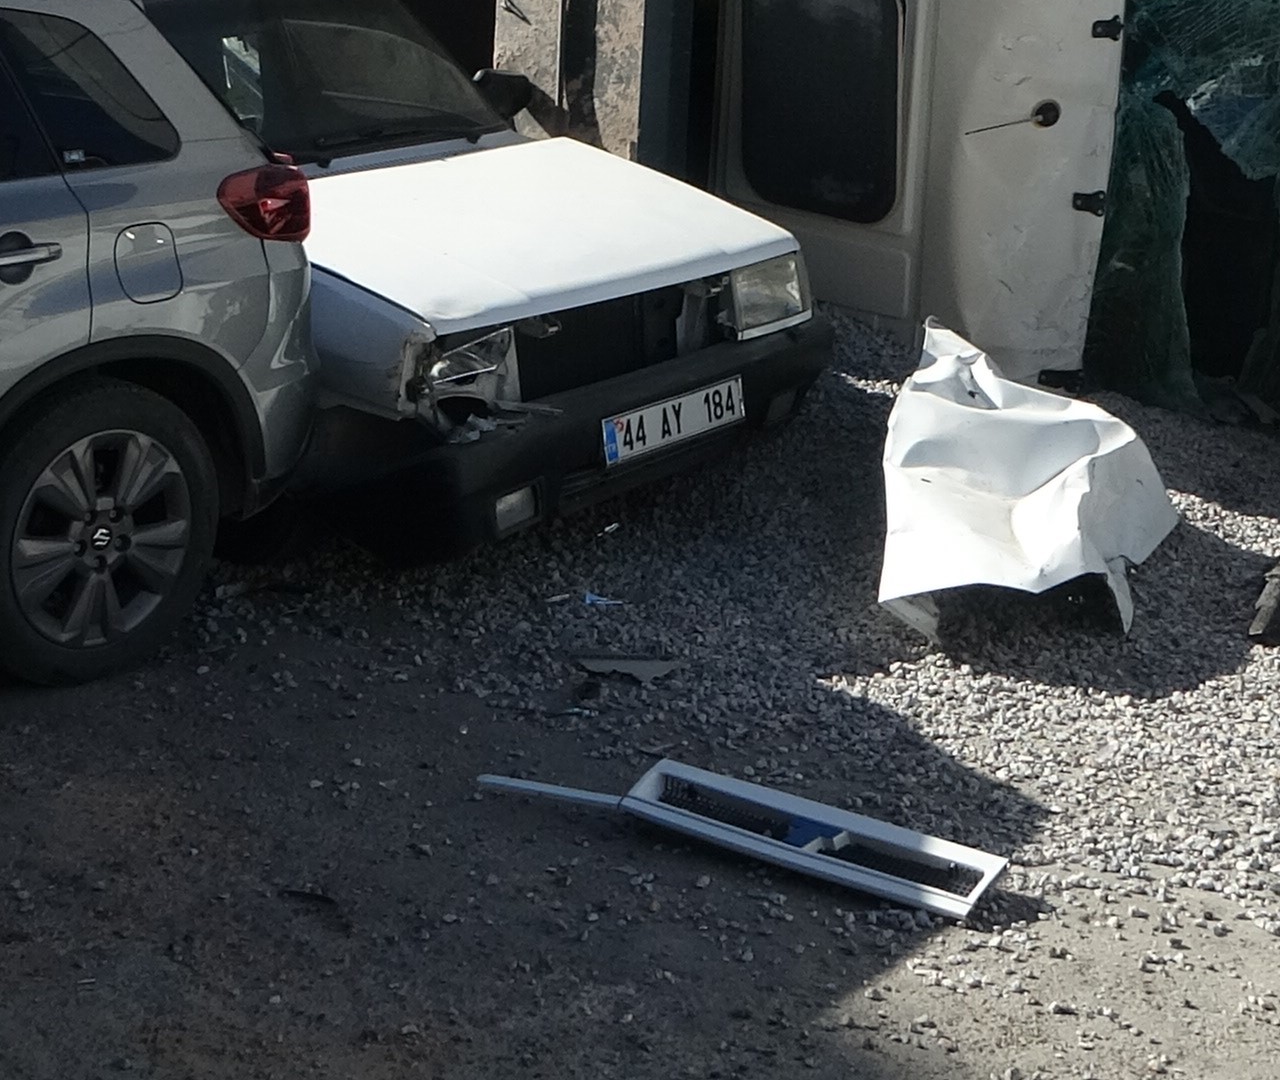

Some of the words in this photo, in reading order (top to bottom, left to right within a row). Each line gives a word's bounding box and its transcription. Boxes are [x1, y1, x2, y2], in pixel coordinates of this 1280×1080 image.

[623, 414, 647, 451] 44
[661, 402, 682, 439] AY
[703, 385, 735, 423] 184
